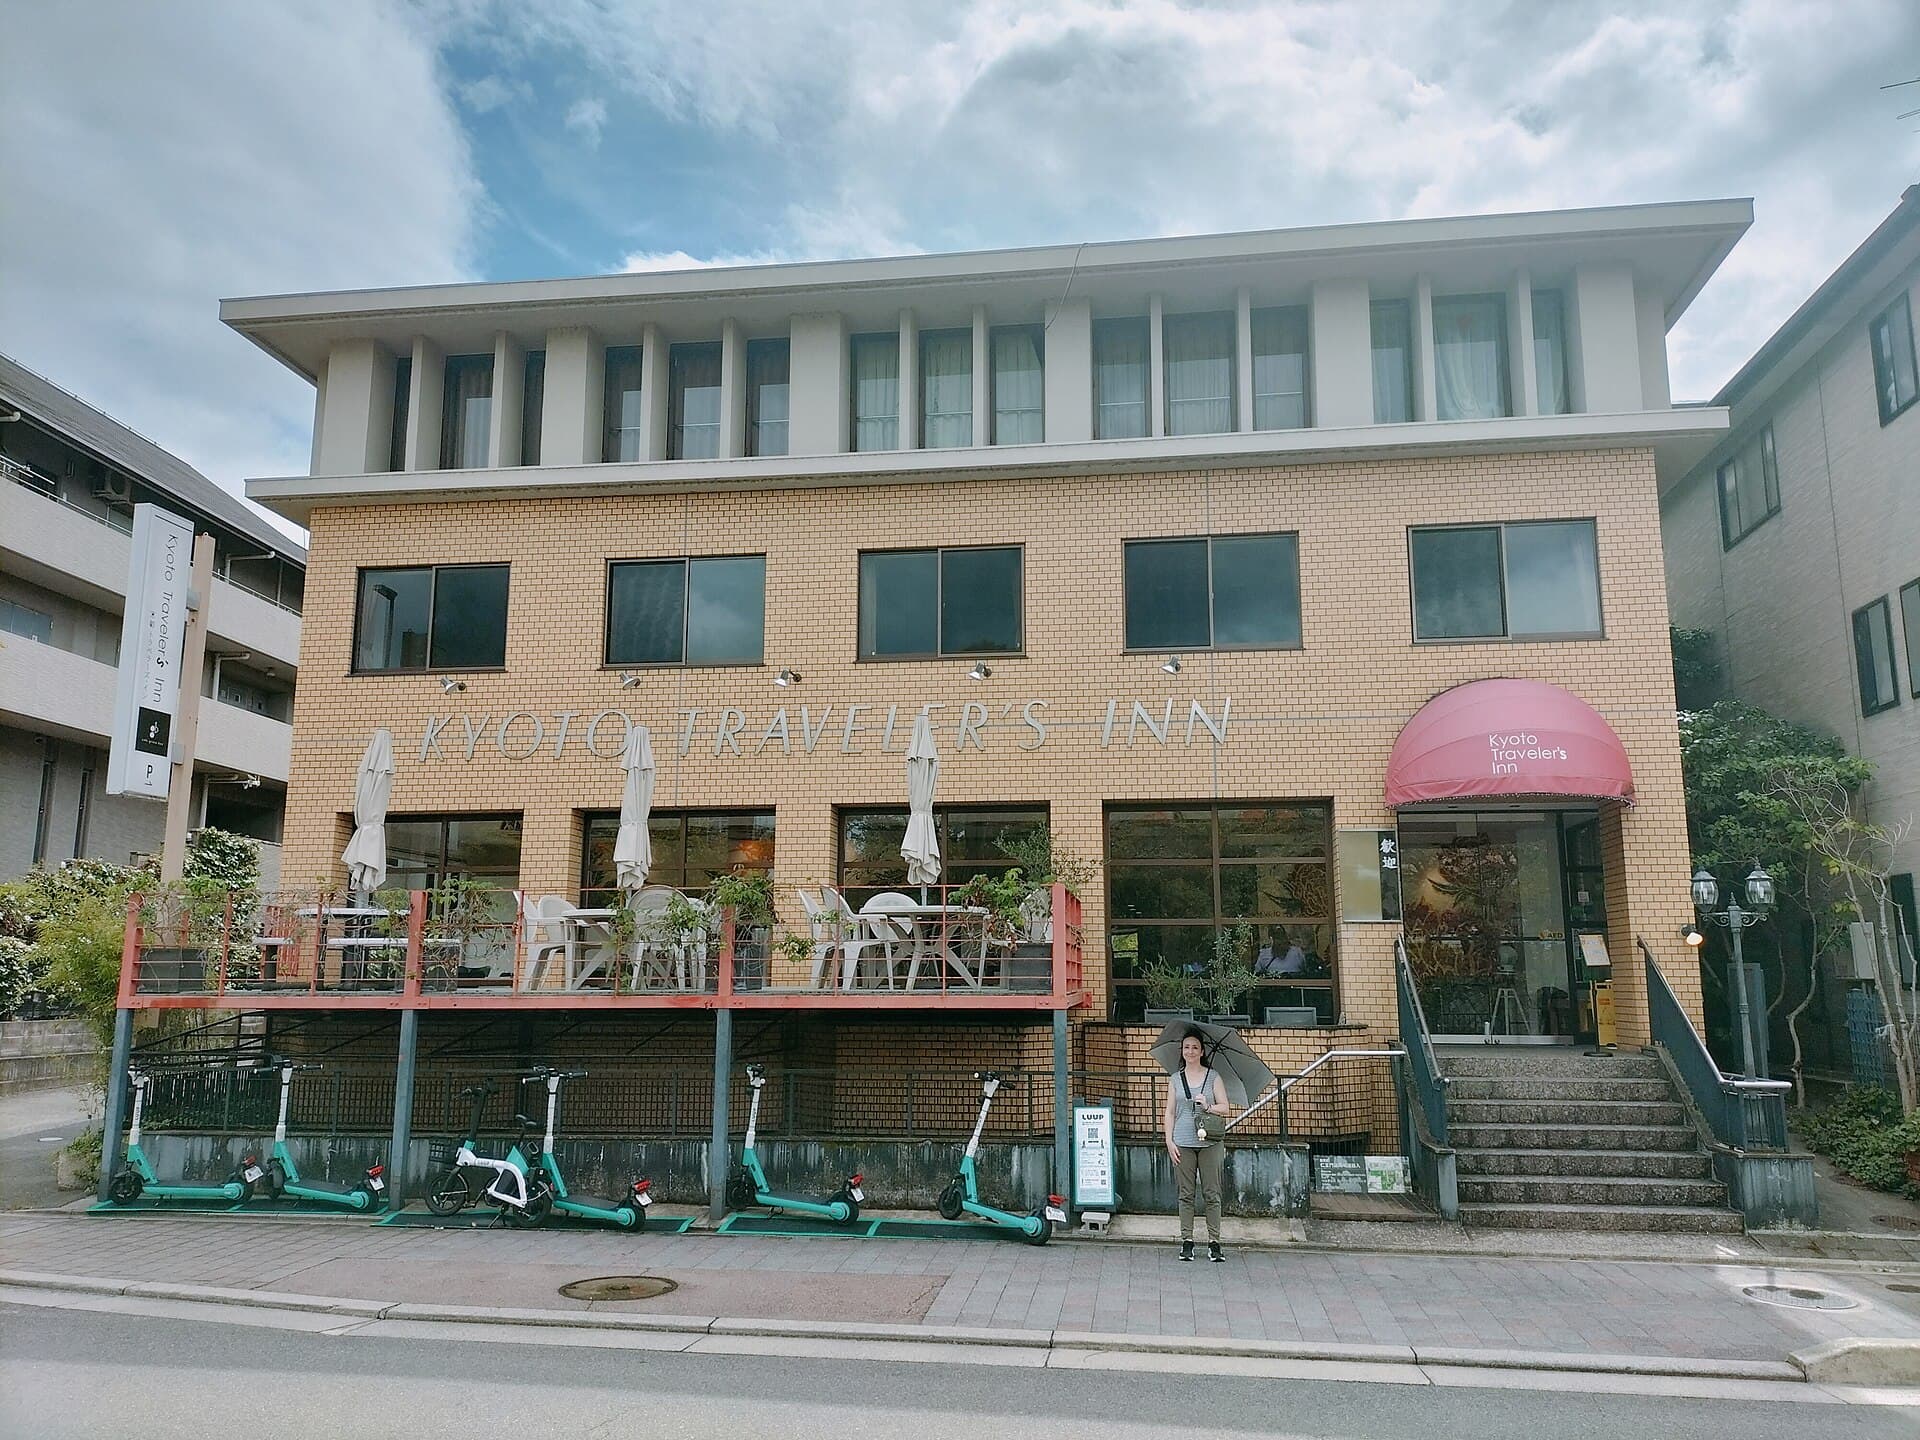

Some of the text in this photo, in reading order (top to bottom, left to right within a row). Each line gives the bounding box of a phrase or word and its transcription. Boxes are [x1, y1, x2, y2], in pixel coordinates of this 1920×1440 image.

[153, 533, 179, 703] Kyoto Traveler's Inn
[418, 710, 634, 763] KYOTO
[1100, 696, 1231, 749] INN
[1489, 732, 1538, 748] Kyoto
[1491, 747, 1567, 760] Traveler's
[146, 764, 153, 779] P
[1492, 761, 1518, 775] Inn
[1380, 838, 1398, 869] 歓迎
